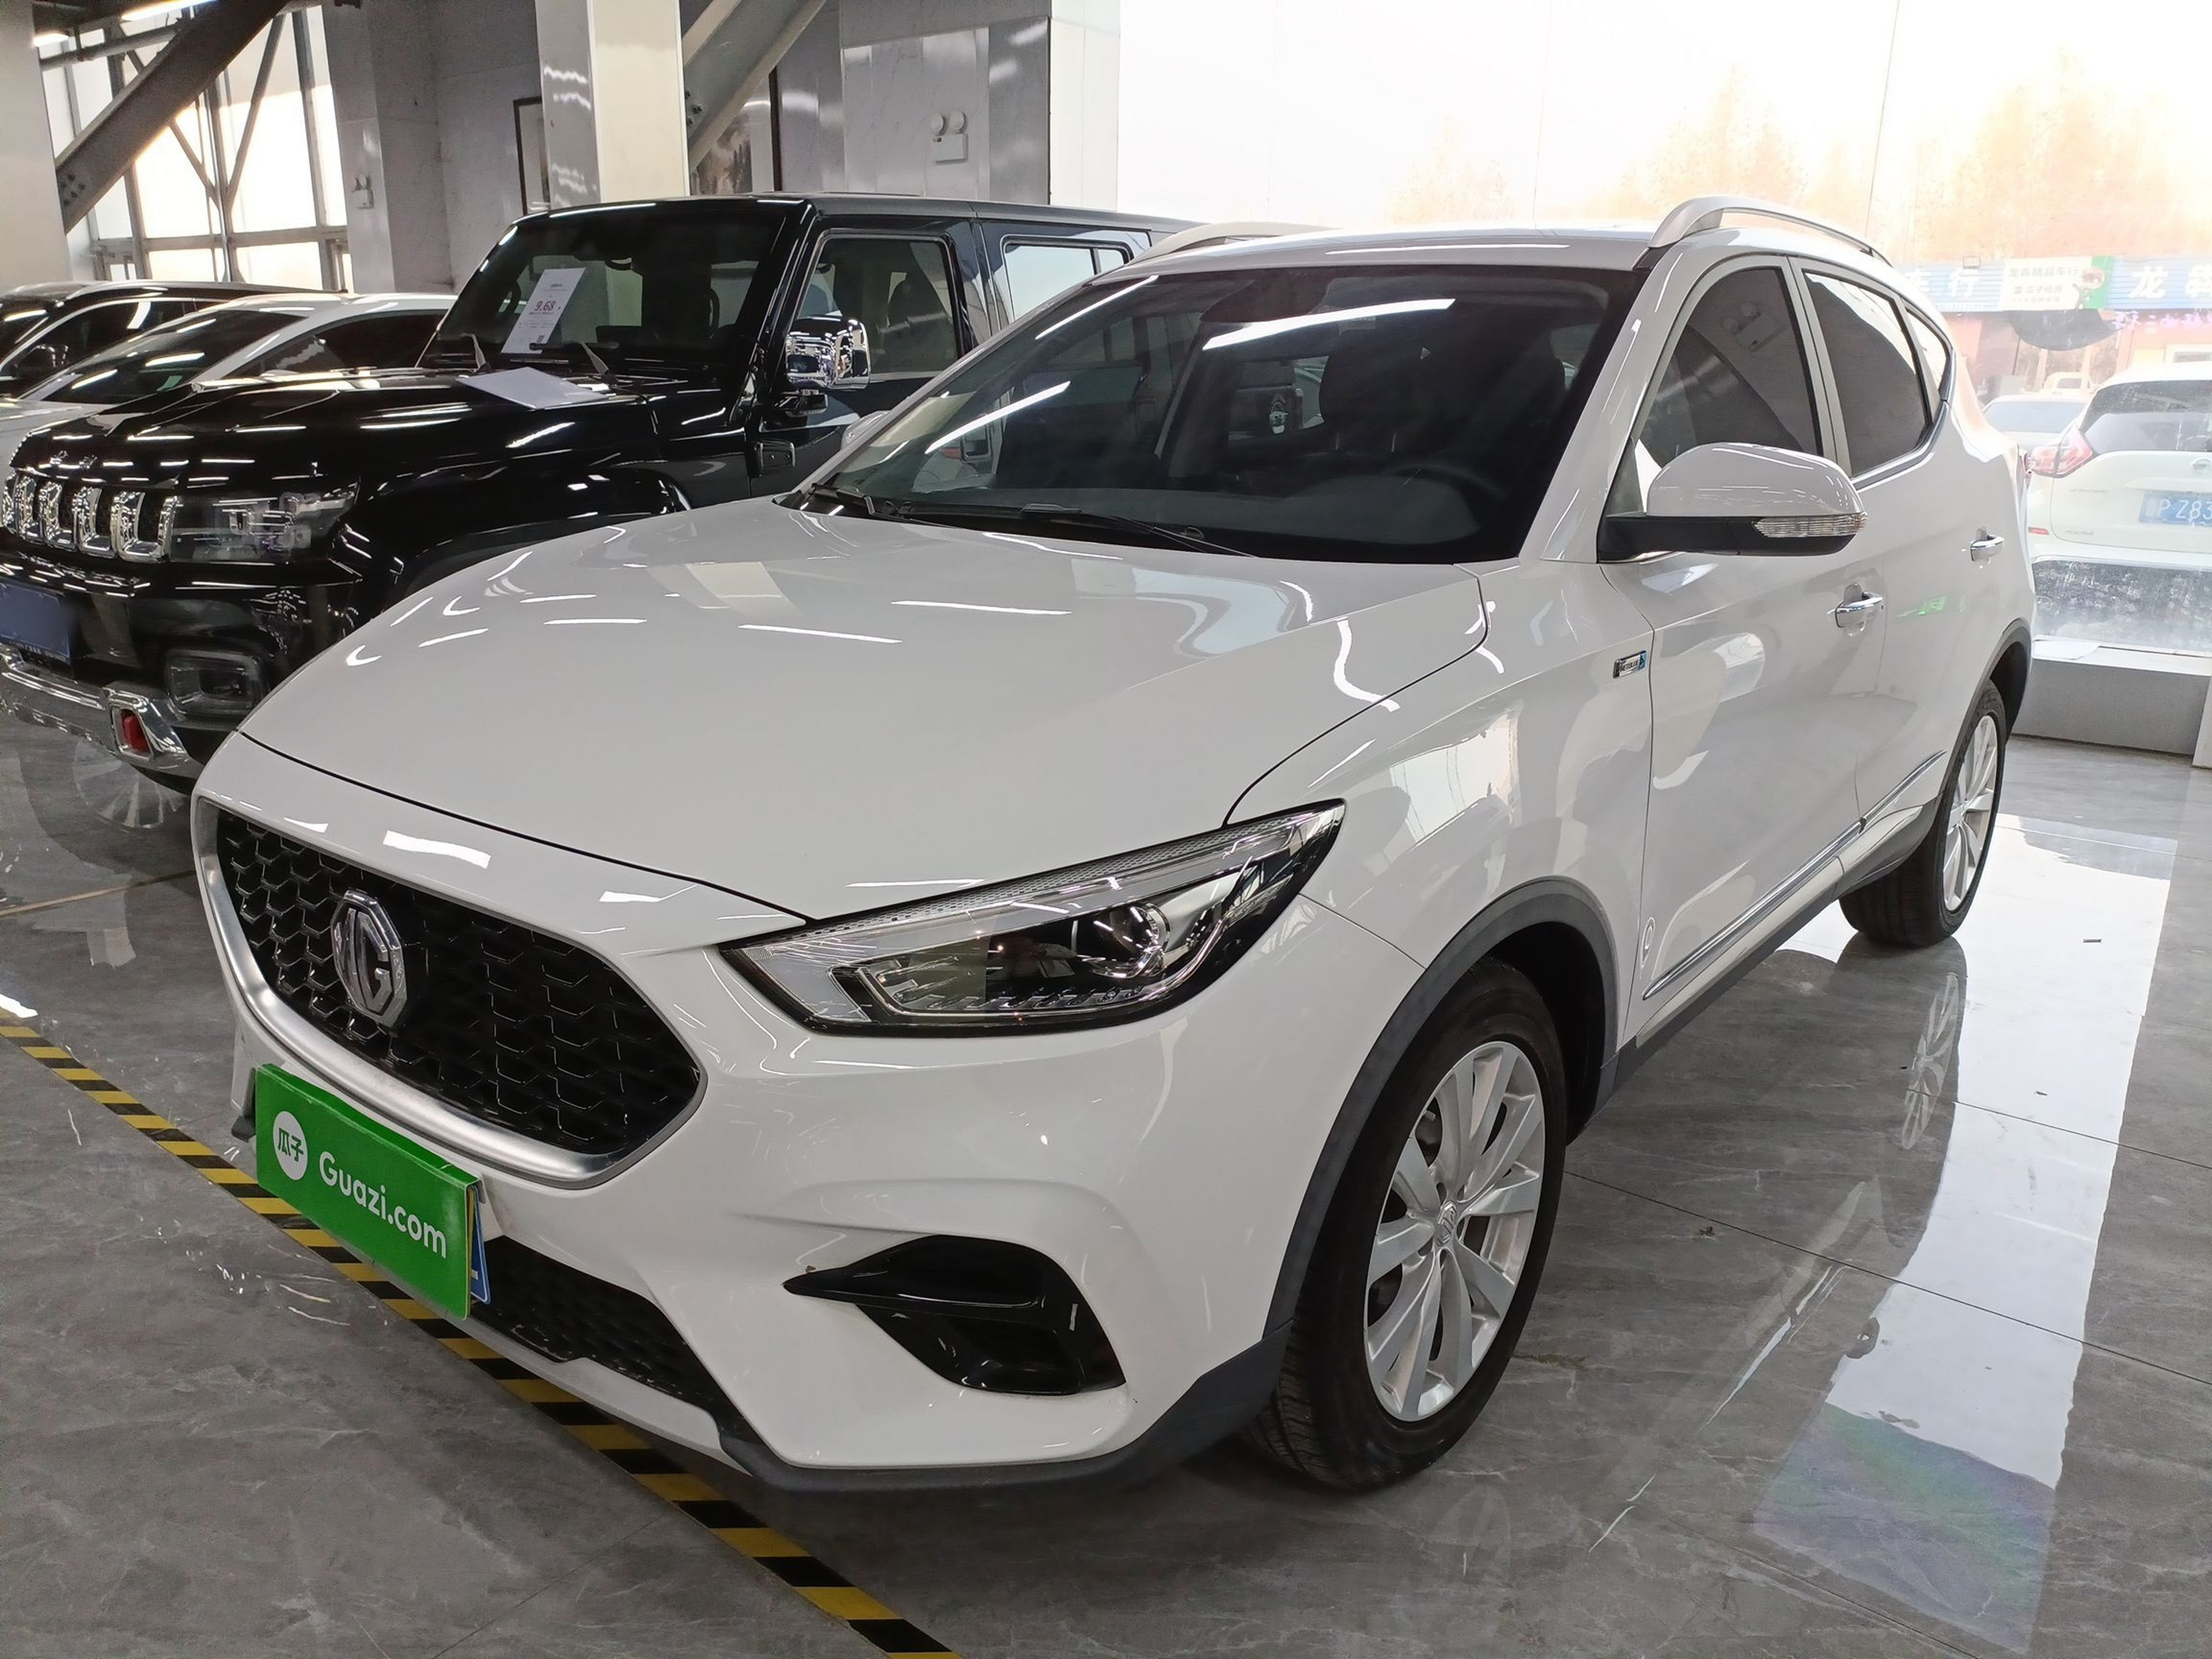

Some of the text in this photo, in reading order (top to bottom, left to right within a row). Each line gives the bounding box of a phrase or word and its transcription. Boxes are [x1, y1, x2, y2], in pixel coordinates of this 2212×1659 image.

[535, 300, 556, 312] 9.68
[278, 1127, 304, 1162] 瓜子
[319, 1152, 446, 1259] Guazi.com
